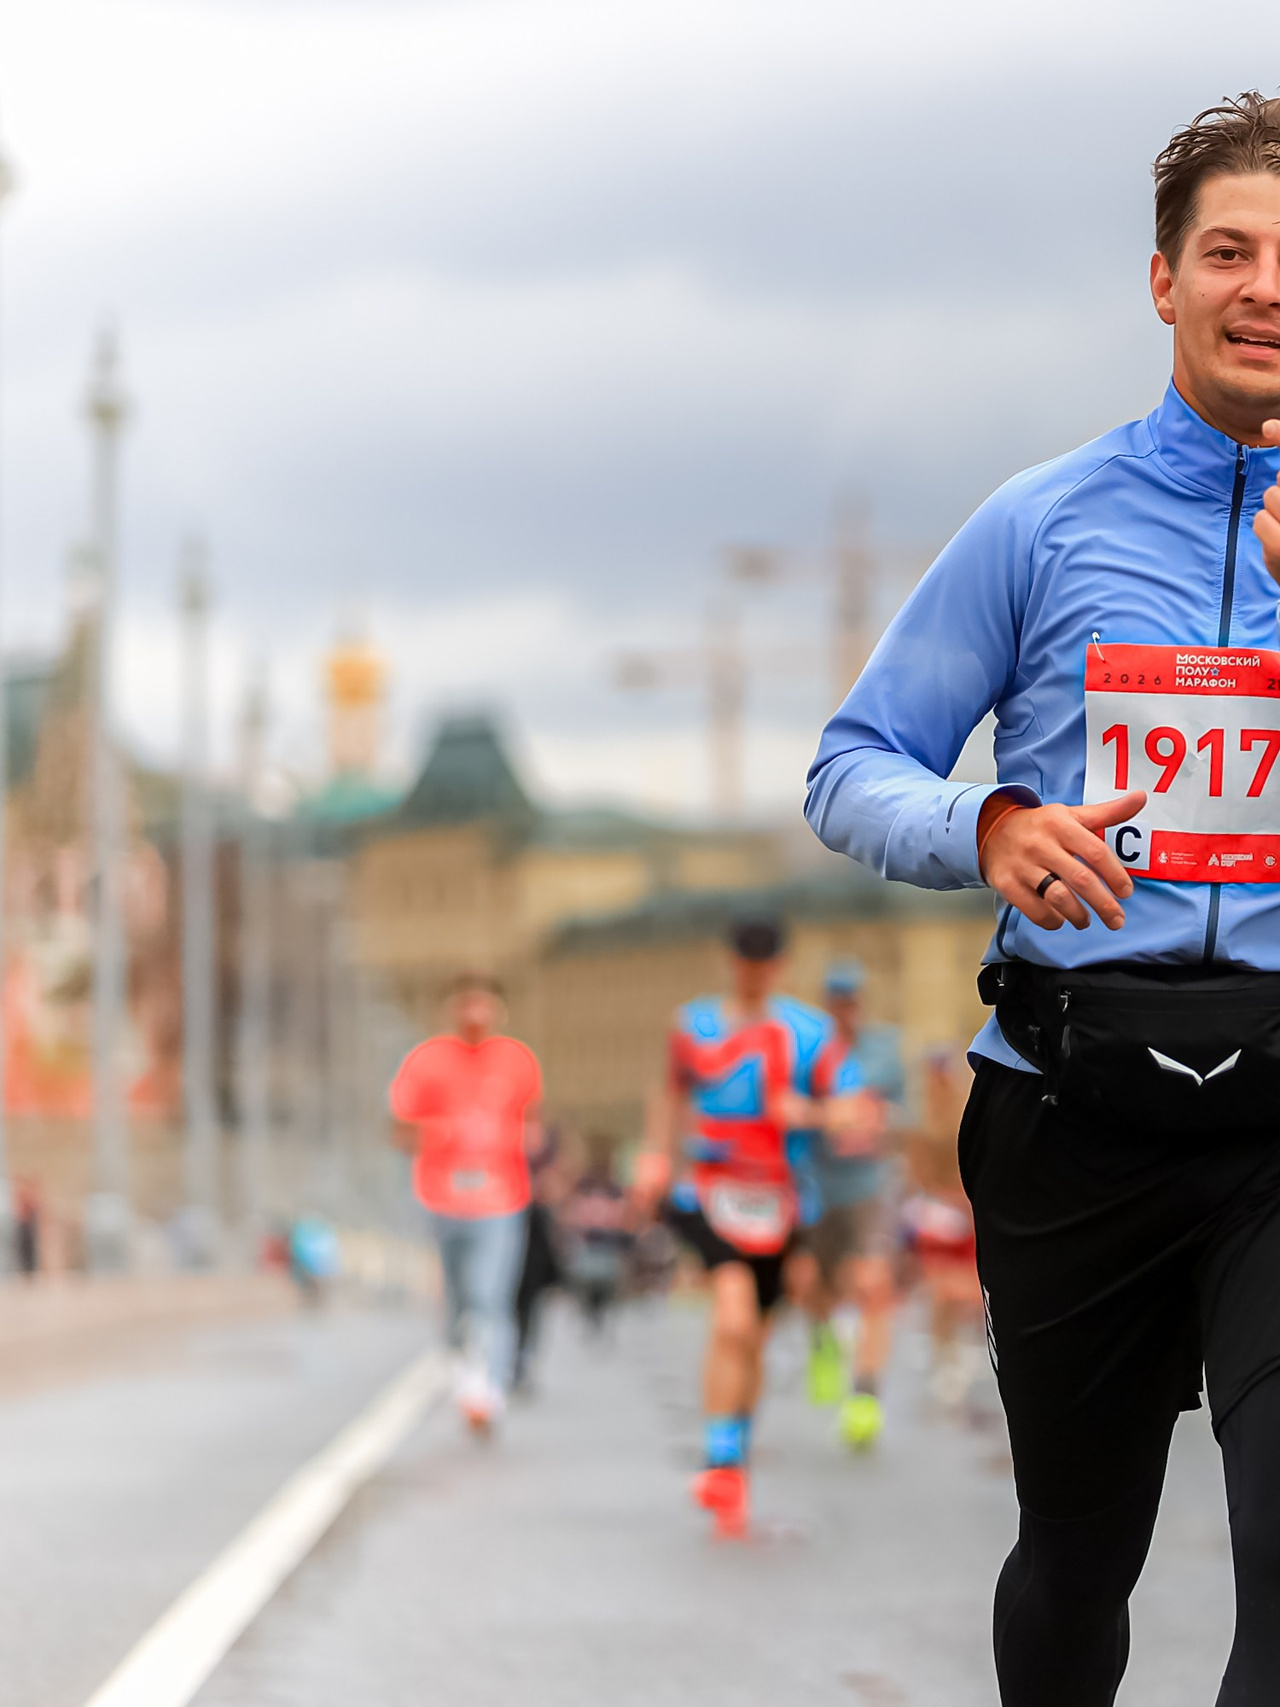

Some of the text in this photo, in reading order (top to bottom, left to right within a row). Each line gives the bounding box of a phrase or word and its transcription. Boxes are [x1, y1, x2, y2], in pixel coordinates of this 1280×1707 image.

[1175, 653, 1261, 667] МОСКОВСКИЙ
[1103, 673, 1162, 685] 2026
[1175, 677, 1236, 689] МАРАФОН
